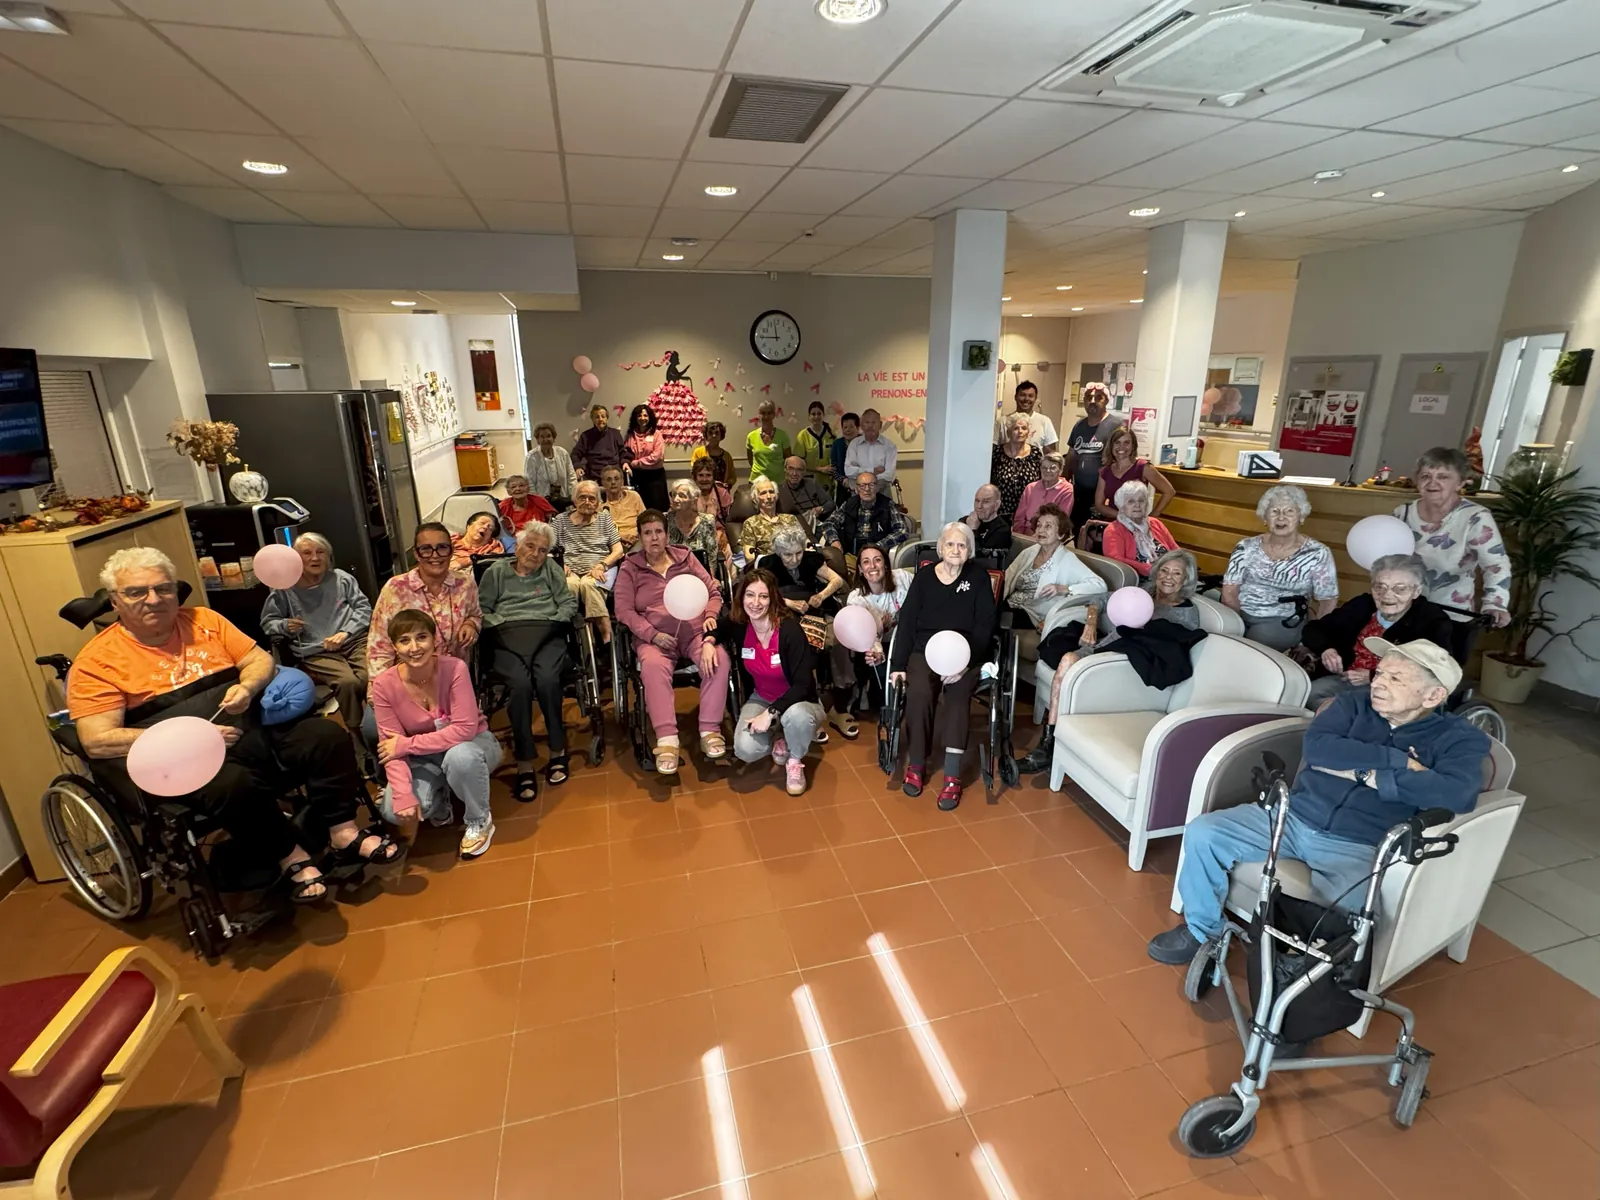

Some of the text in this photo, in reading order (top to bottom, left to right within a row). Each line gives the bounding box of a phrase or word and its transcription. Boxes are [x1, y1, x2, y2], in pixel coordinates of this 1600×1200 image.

[857, 372, 870, 382] LA
[892, 372, 908, 382] EST
[912, 371, 926, 381] UN
[871, 388, 927, 398] PRENONS-EN
